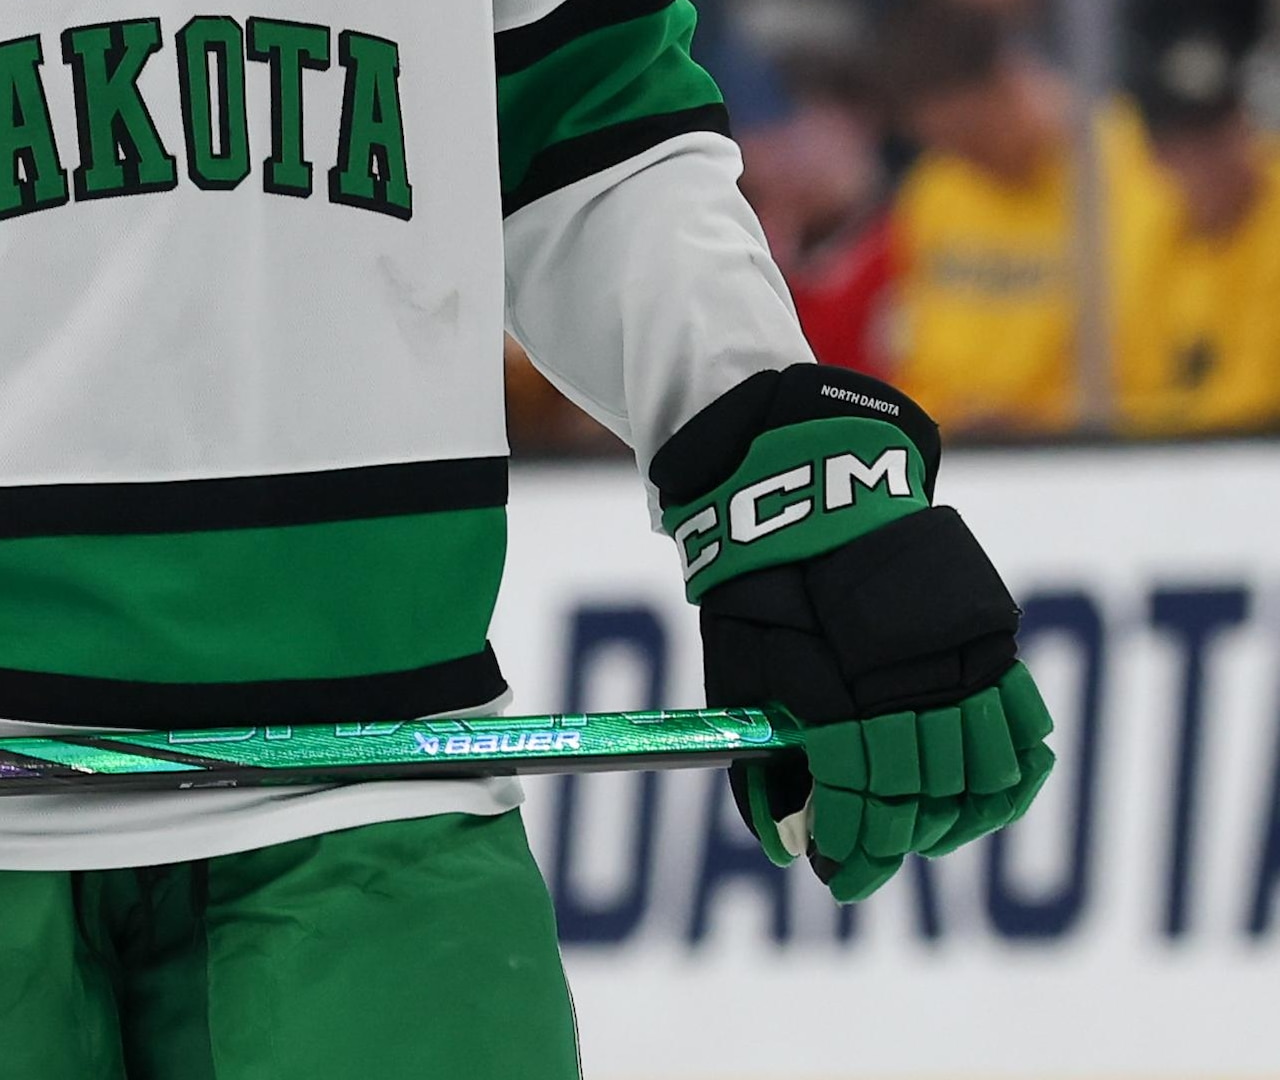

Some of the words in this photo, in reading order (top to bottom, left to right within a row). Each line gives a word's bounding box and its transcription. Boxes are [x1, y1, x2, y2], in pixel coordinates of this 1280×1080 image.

[821, 384, 860, 404] NORTH
[860, 395, 900, 416] DAKOTA
[674, 447, 912, 582] CCM
[444, 731, 581, 753] BAUER
